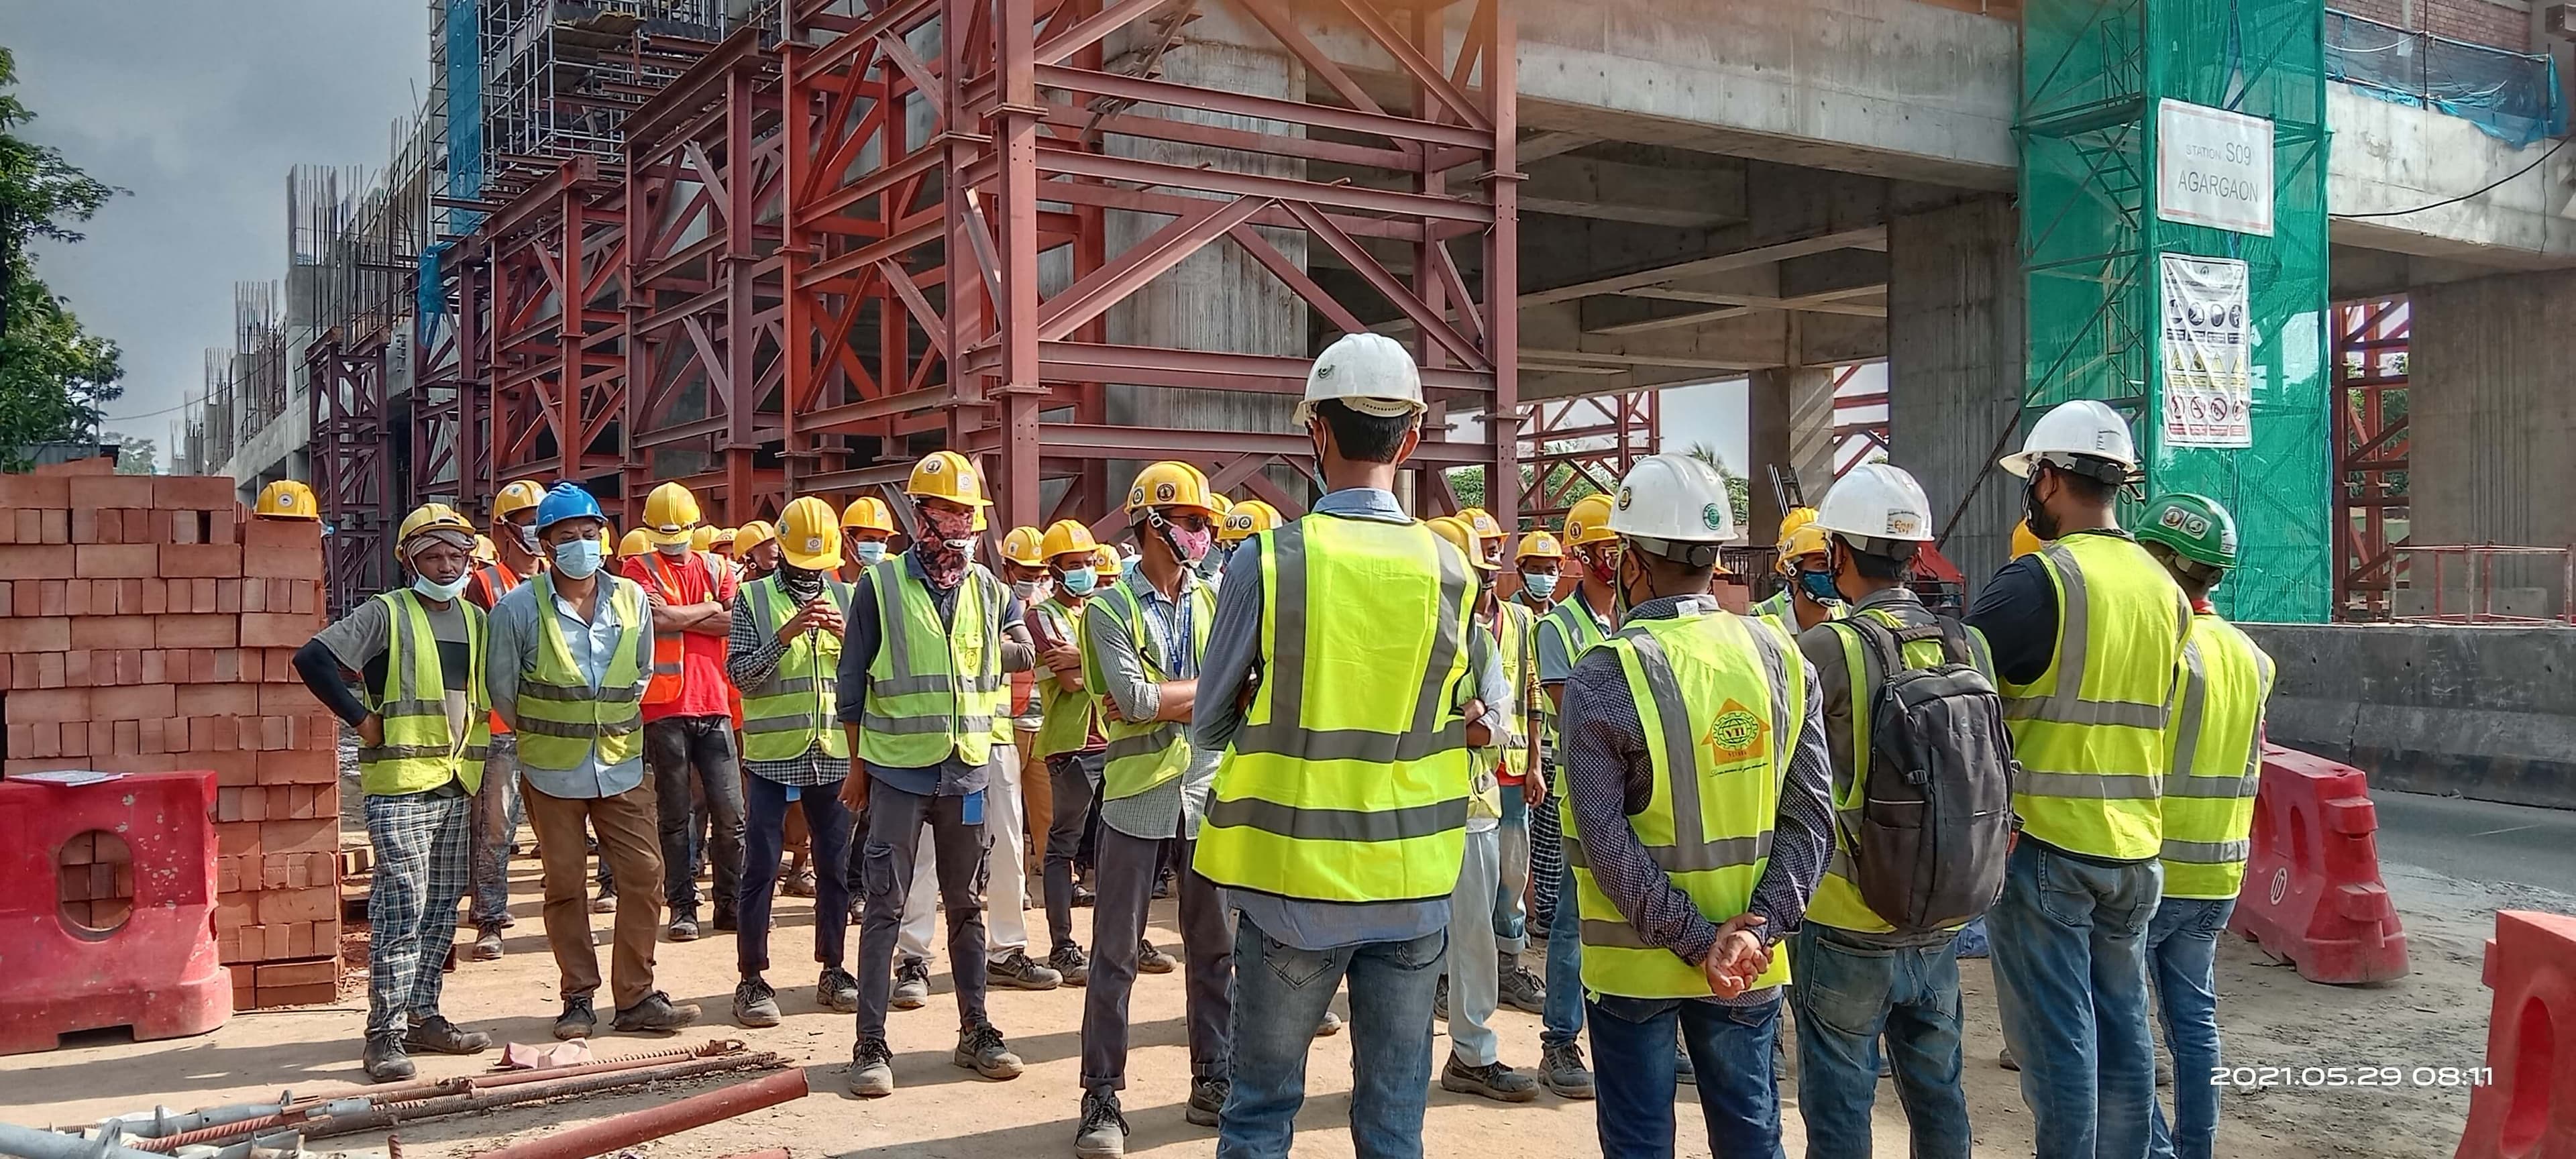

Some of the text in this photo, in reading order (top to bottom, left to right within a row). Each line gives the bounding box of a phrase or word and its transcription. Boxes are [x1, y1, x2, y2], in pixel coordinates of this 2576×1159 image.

[2186, 142, 2251, 166] STATION S09
[2178, 170, 2258, 202] AGARGAON
